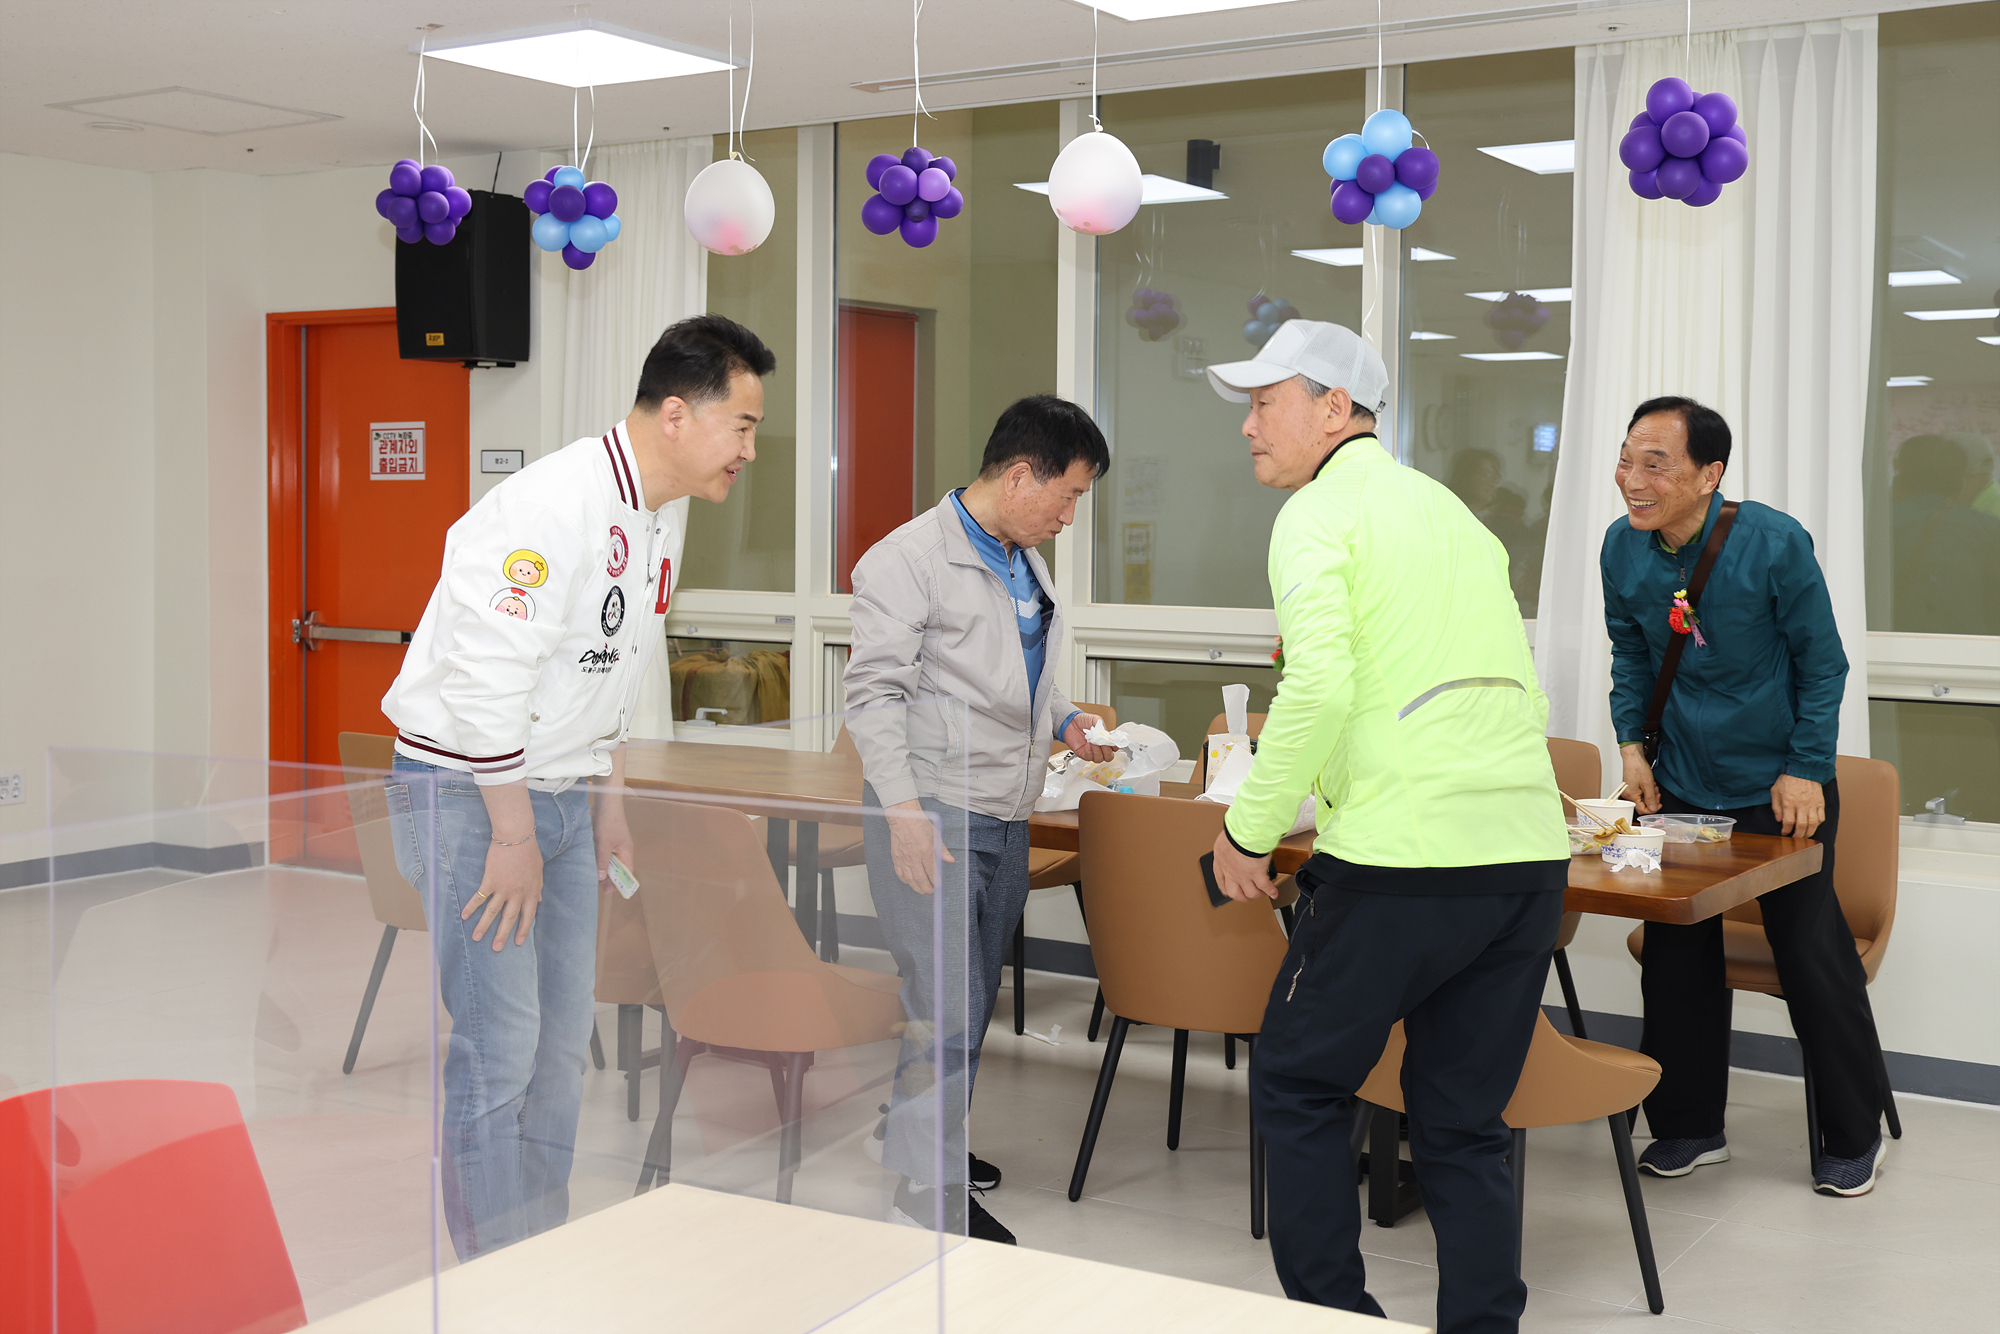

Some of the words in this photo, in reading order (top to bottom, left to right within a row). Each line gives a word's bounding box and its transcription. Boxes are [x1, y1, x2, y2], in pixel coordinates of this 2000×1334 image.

[383, 432, 396, 440] CCTV
[378, 439, 418, 455] 관계자외
[378, 457, 418, 473] 출입금지
[655, 557, 671, 614] D
